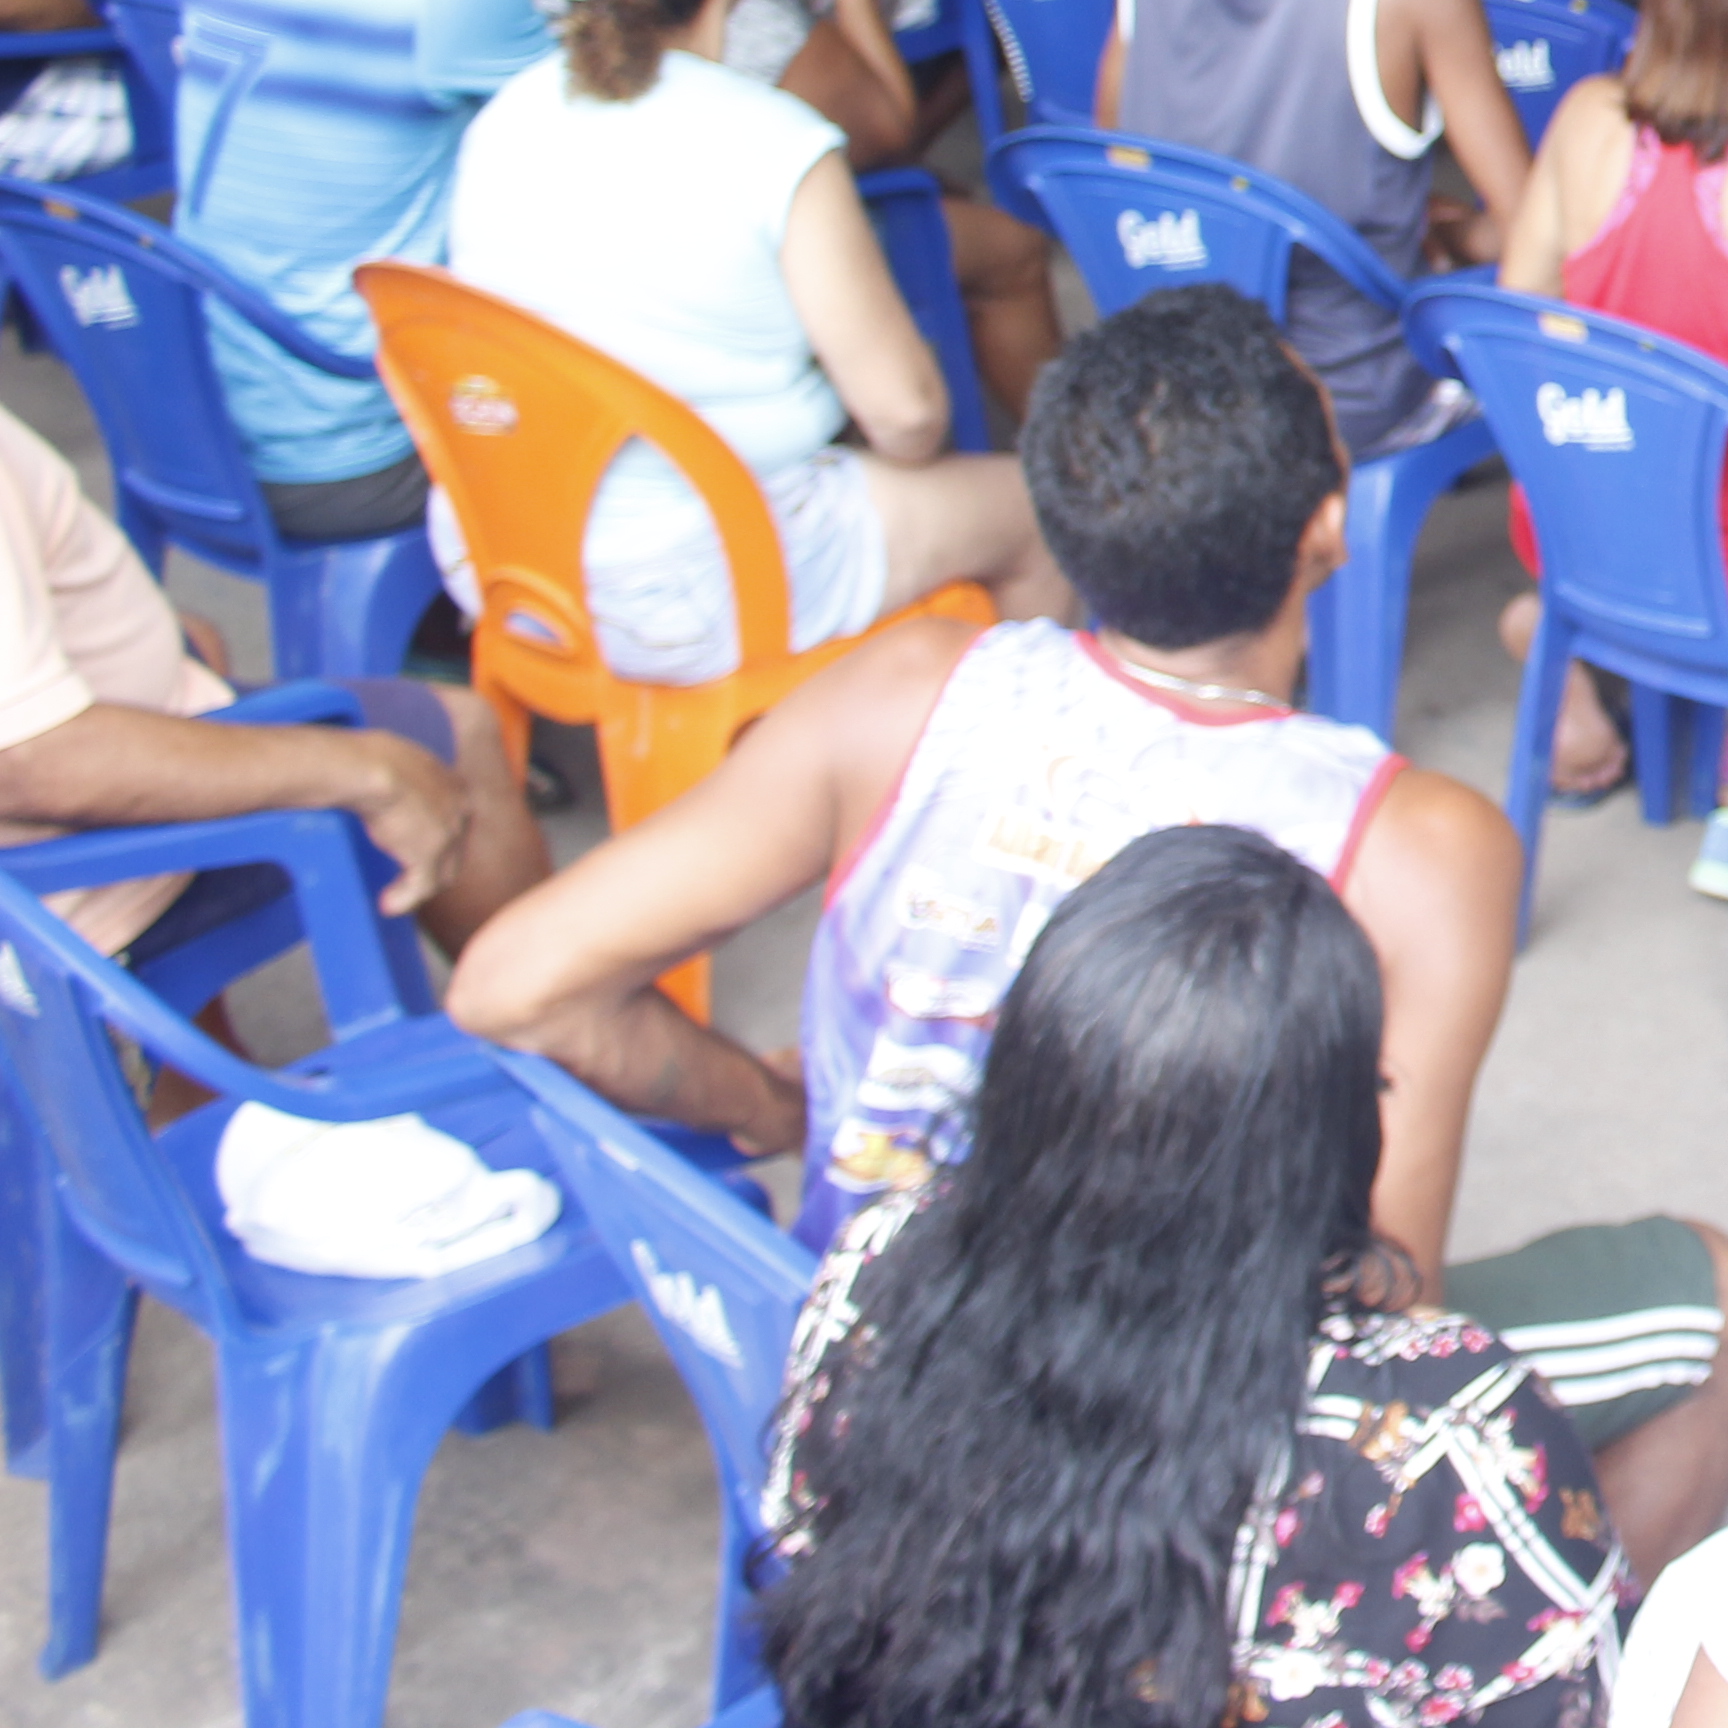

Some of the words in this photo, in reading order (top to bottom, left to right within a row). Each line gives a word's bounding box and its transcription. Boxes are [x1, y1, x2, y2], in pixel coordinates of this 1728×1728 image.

[1493, 37, 1556, 87] old
[1117, 208, 1208, 269] Gold
[59, 262, 138, 329] Gold
[1536, 381, 1634, 446] Gold
